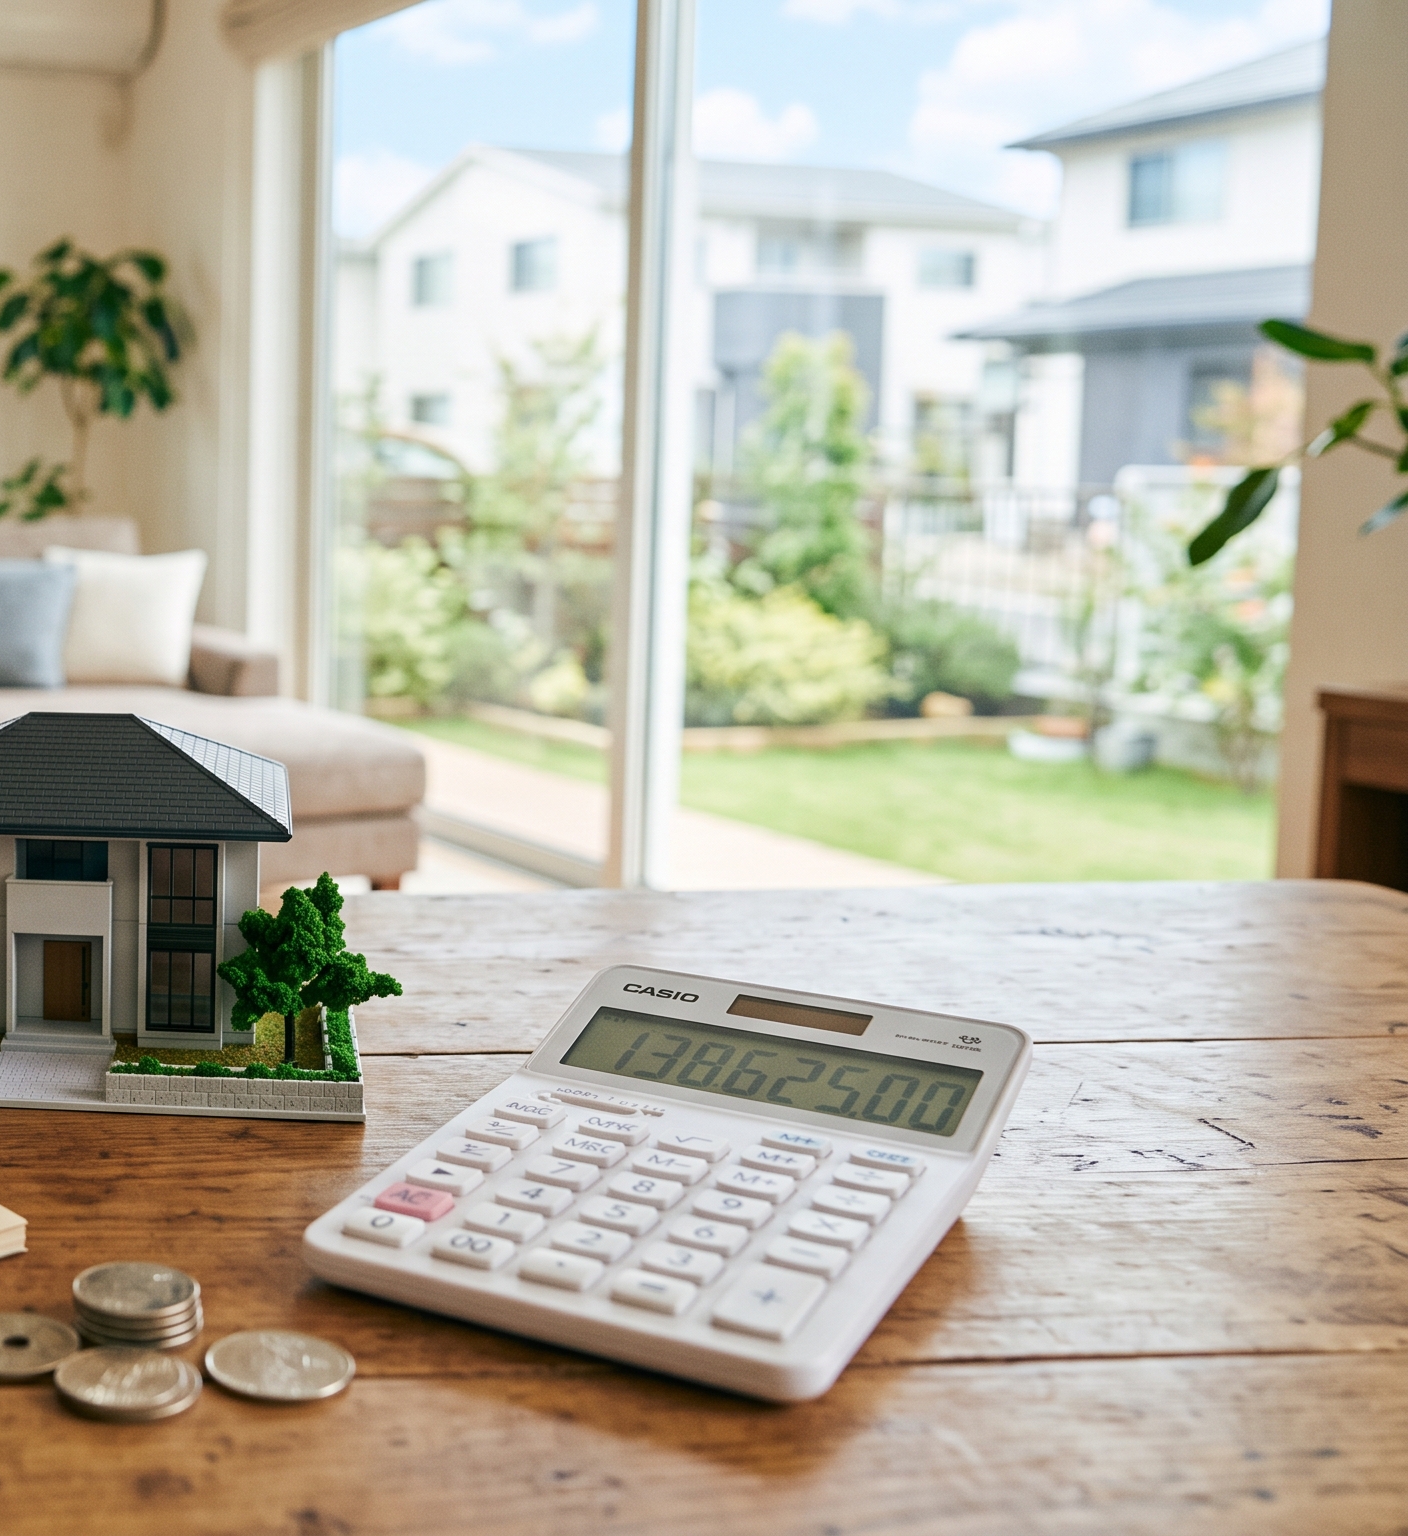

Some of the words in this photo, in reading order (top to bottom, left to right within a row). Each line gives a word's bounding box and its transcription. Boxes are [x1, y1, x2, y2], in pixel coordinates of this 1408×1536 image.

[623, 983, 699, 1003] CASIO
[549, 1161, 575, 1174] 7
[520, 1187, 545, 1200] 4
[631, 1179, 656, 1194] 8
[603, 1204, 631, 1219] 5
[719, 1198, 743, 1210] 9
[370, 1214, 394, 1229] 0
[496, 1212, 511, 1225] 1
[575, 1230, 602, 1245] 2
[694, 1225, 717, 1239] 6
[450, 1233, 493, 1253] 00
[666, 1250, 695, 1267] 3
